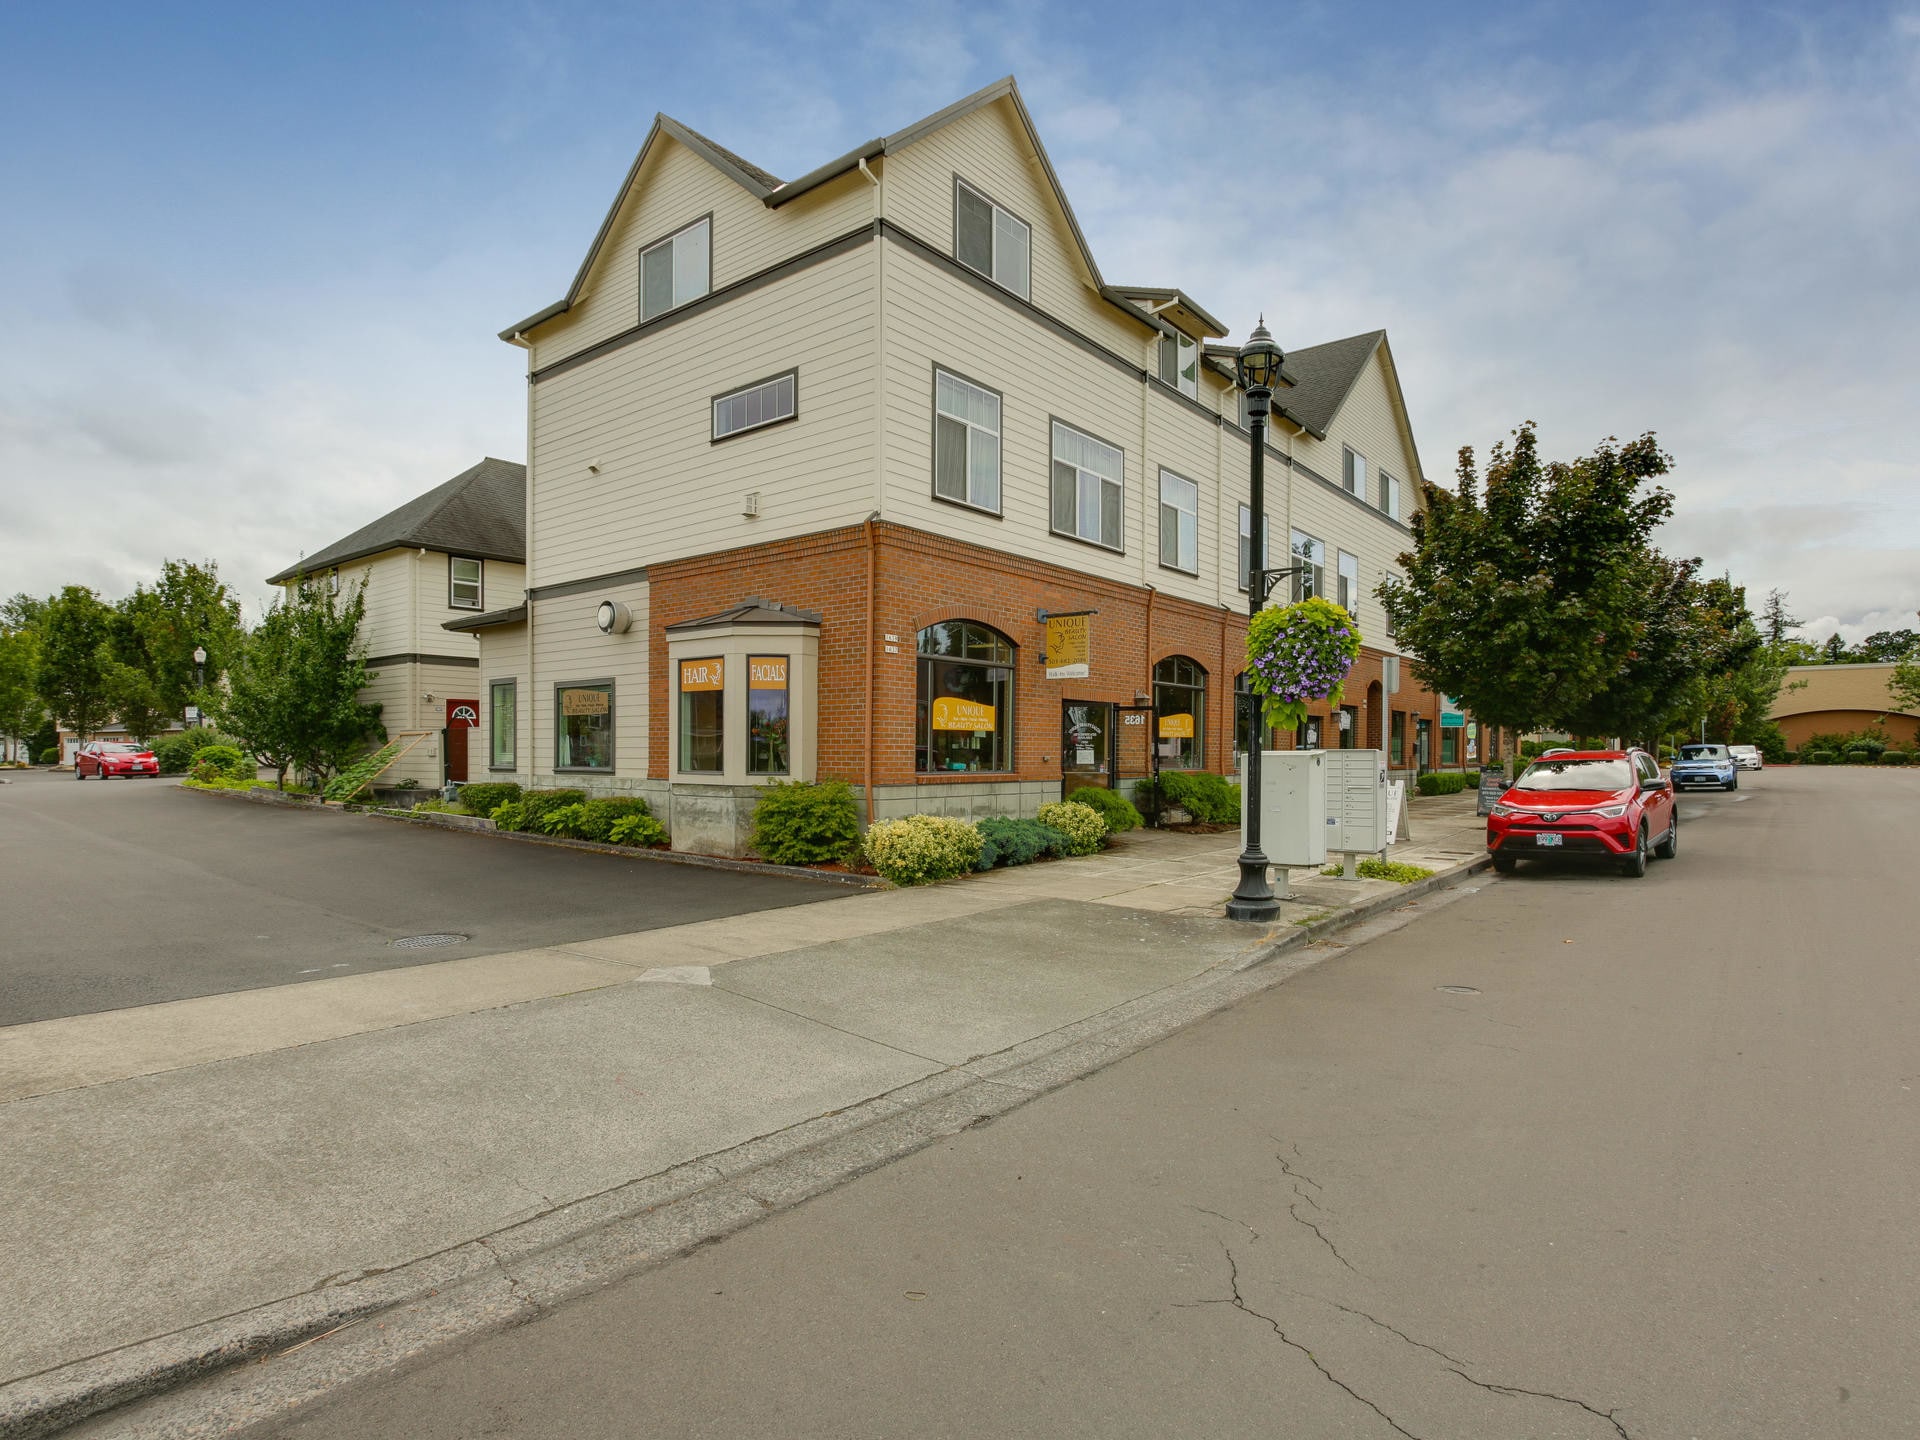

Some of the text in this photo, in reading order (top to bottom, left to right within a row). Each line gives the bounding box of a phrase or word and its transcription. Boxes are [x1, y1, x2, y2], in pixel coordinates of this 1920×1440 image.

[1048, 617, 1086, 629] UNIQUE
[683, 666, 708, 685] HAIR
[751, 664, 785, 682] FACIALS
[956, 704, 985, 717] UNIQUE
